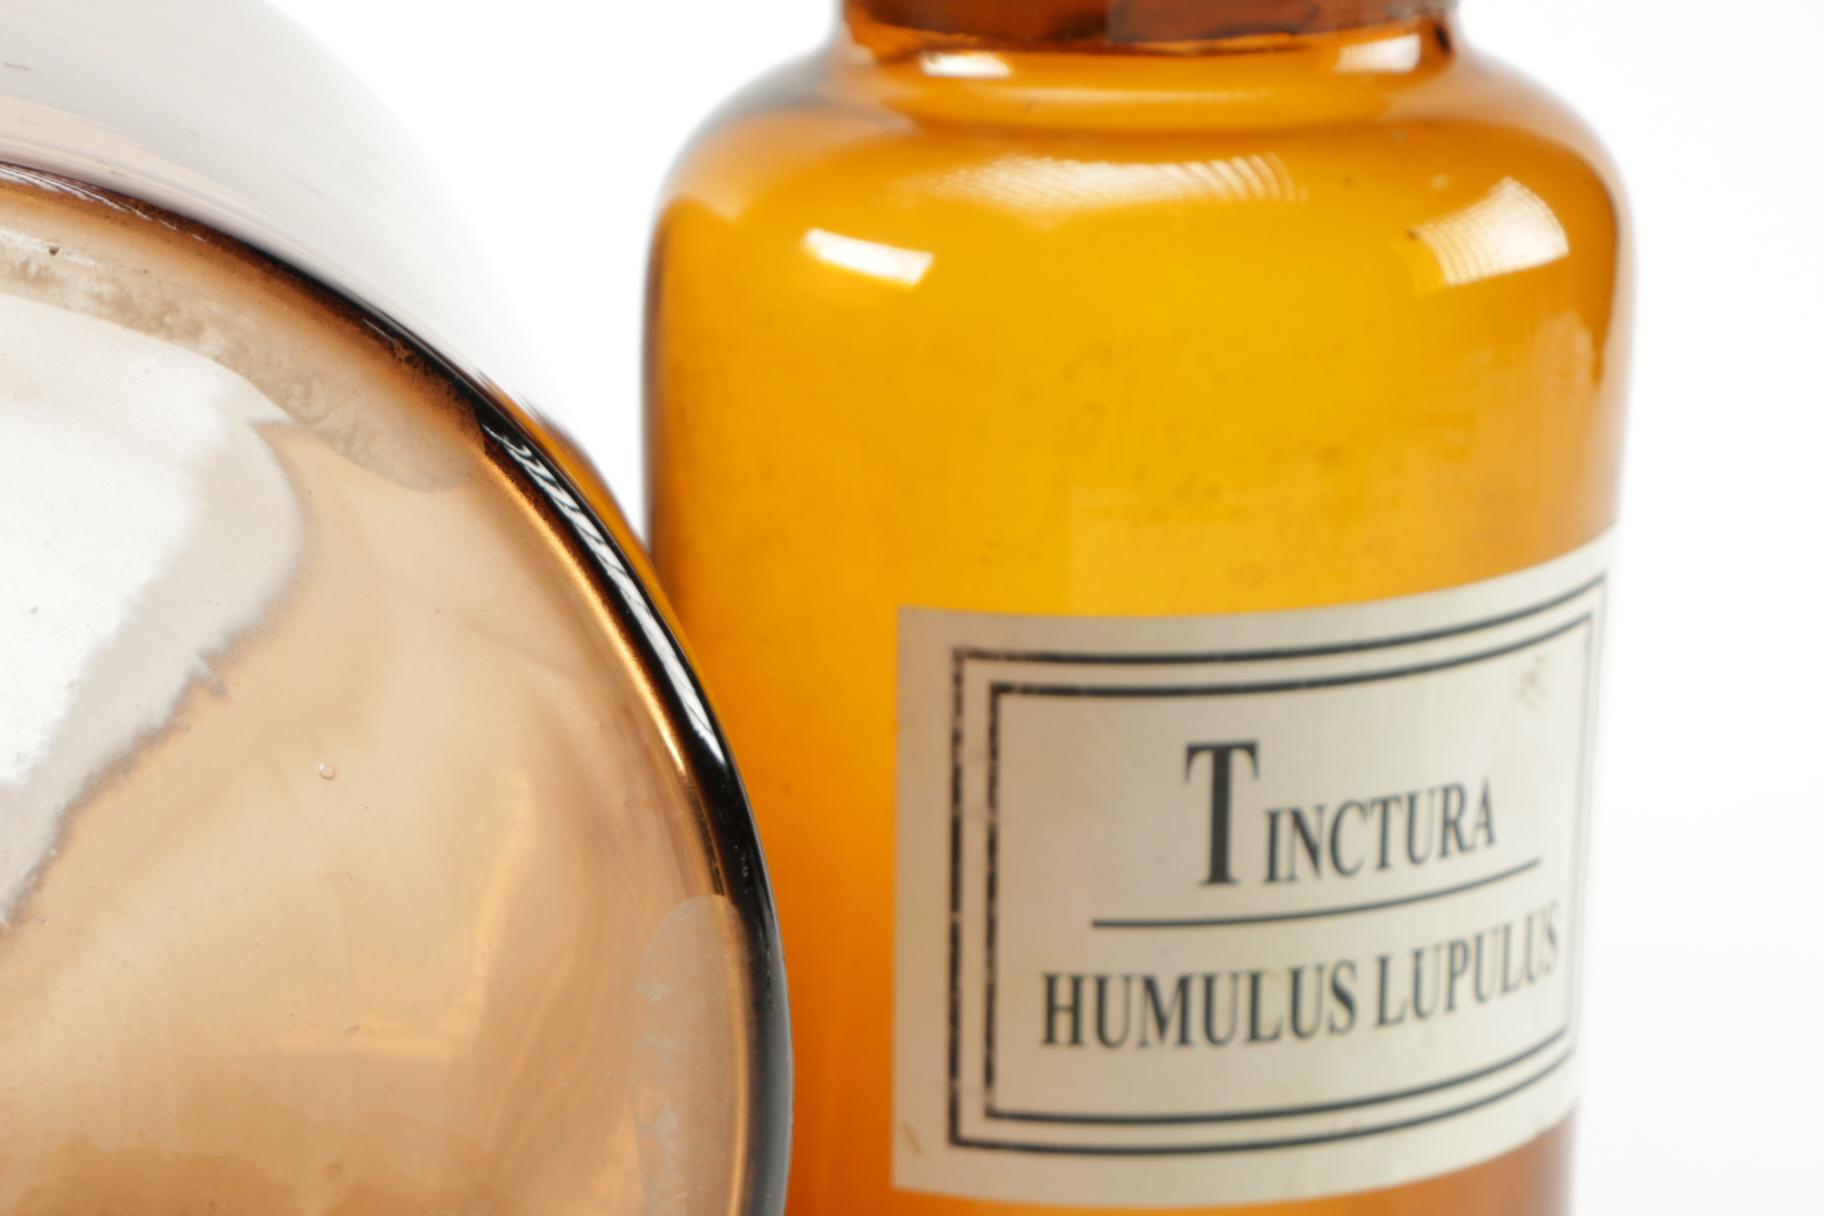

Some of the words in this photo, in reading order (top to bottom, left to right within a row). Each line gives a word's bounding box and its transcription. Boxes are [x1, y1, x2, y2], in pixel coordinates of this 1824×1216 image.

[1184, 740, 1497, 886] TINCTURA
[1040, 962, 1360, 1049] HUMULUS
[1374, 900, 1560, 1028] LUPULUS
